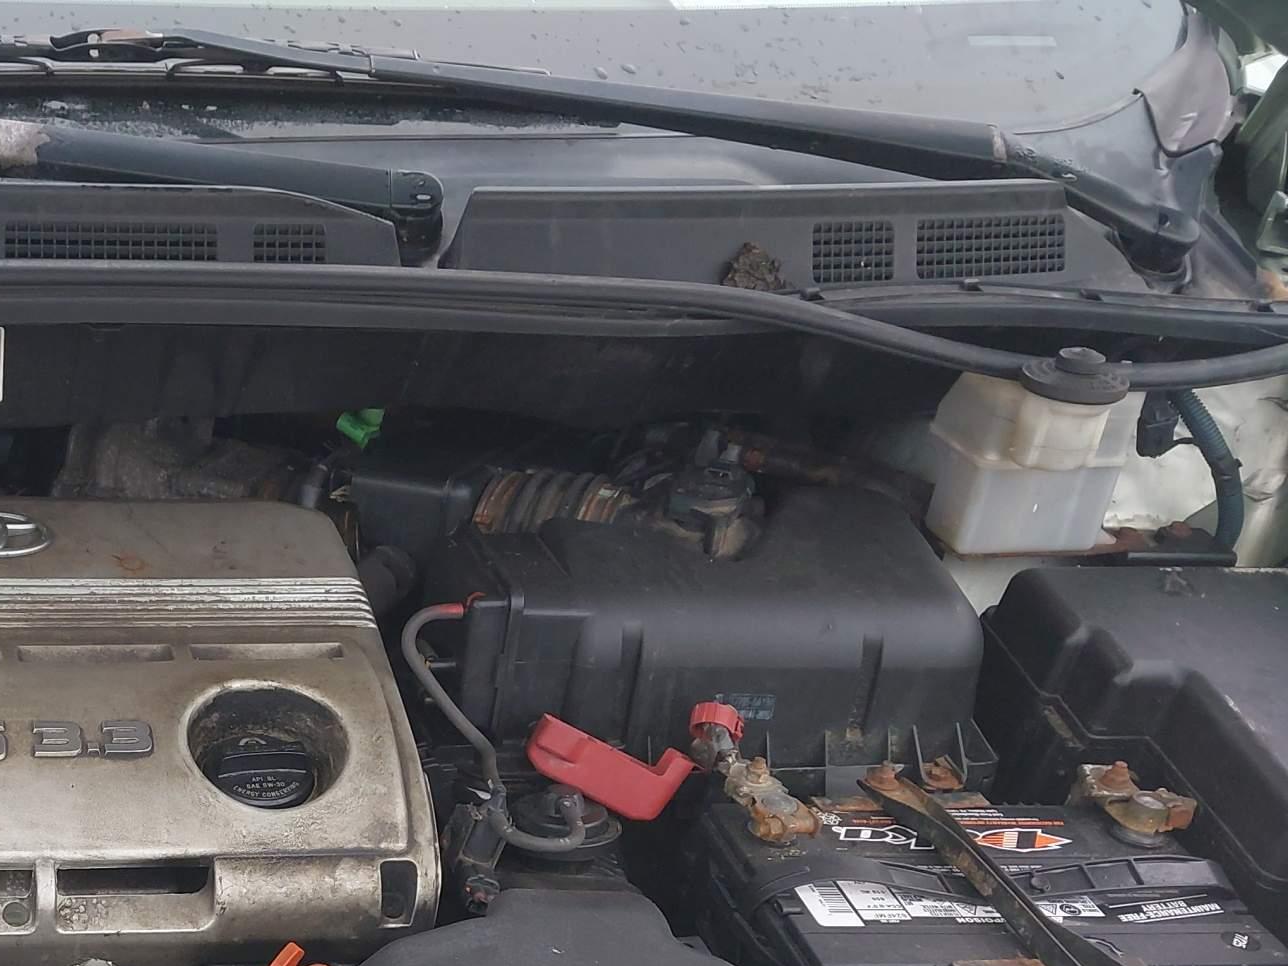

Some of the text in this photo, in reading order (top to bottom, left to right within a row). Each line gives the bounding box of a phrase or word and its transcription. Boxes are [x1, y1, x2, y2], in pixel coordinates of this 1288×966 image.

[31, 719, 156, 758] 3.3
[232, 781, 300, 798] ENERGY CONSERVING
[246, 782, 261, 790] SAE
[1117, 902, 1221, 922] MAINTENANCE-FREE
[1141, 900, 1187, 912] BATTERY
